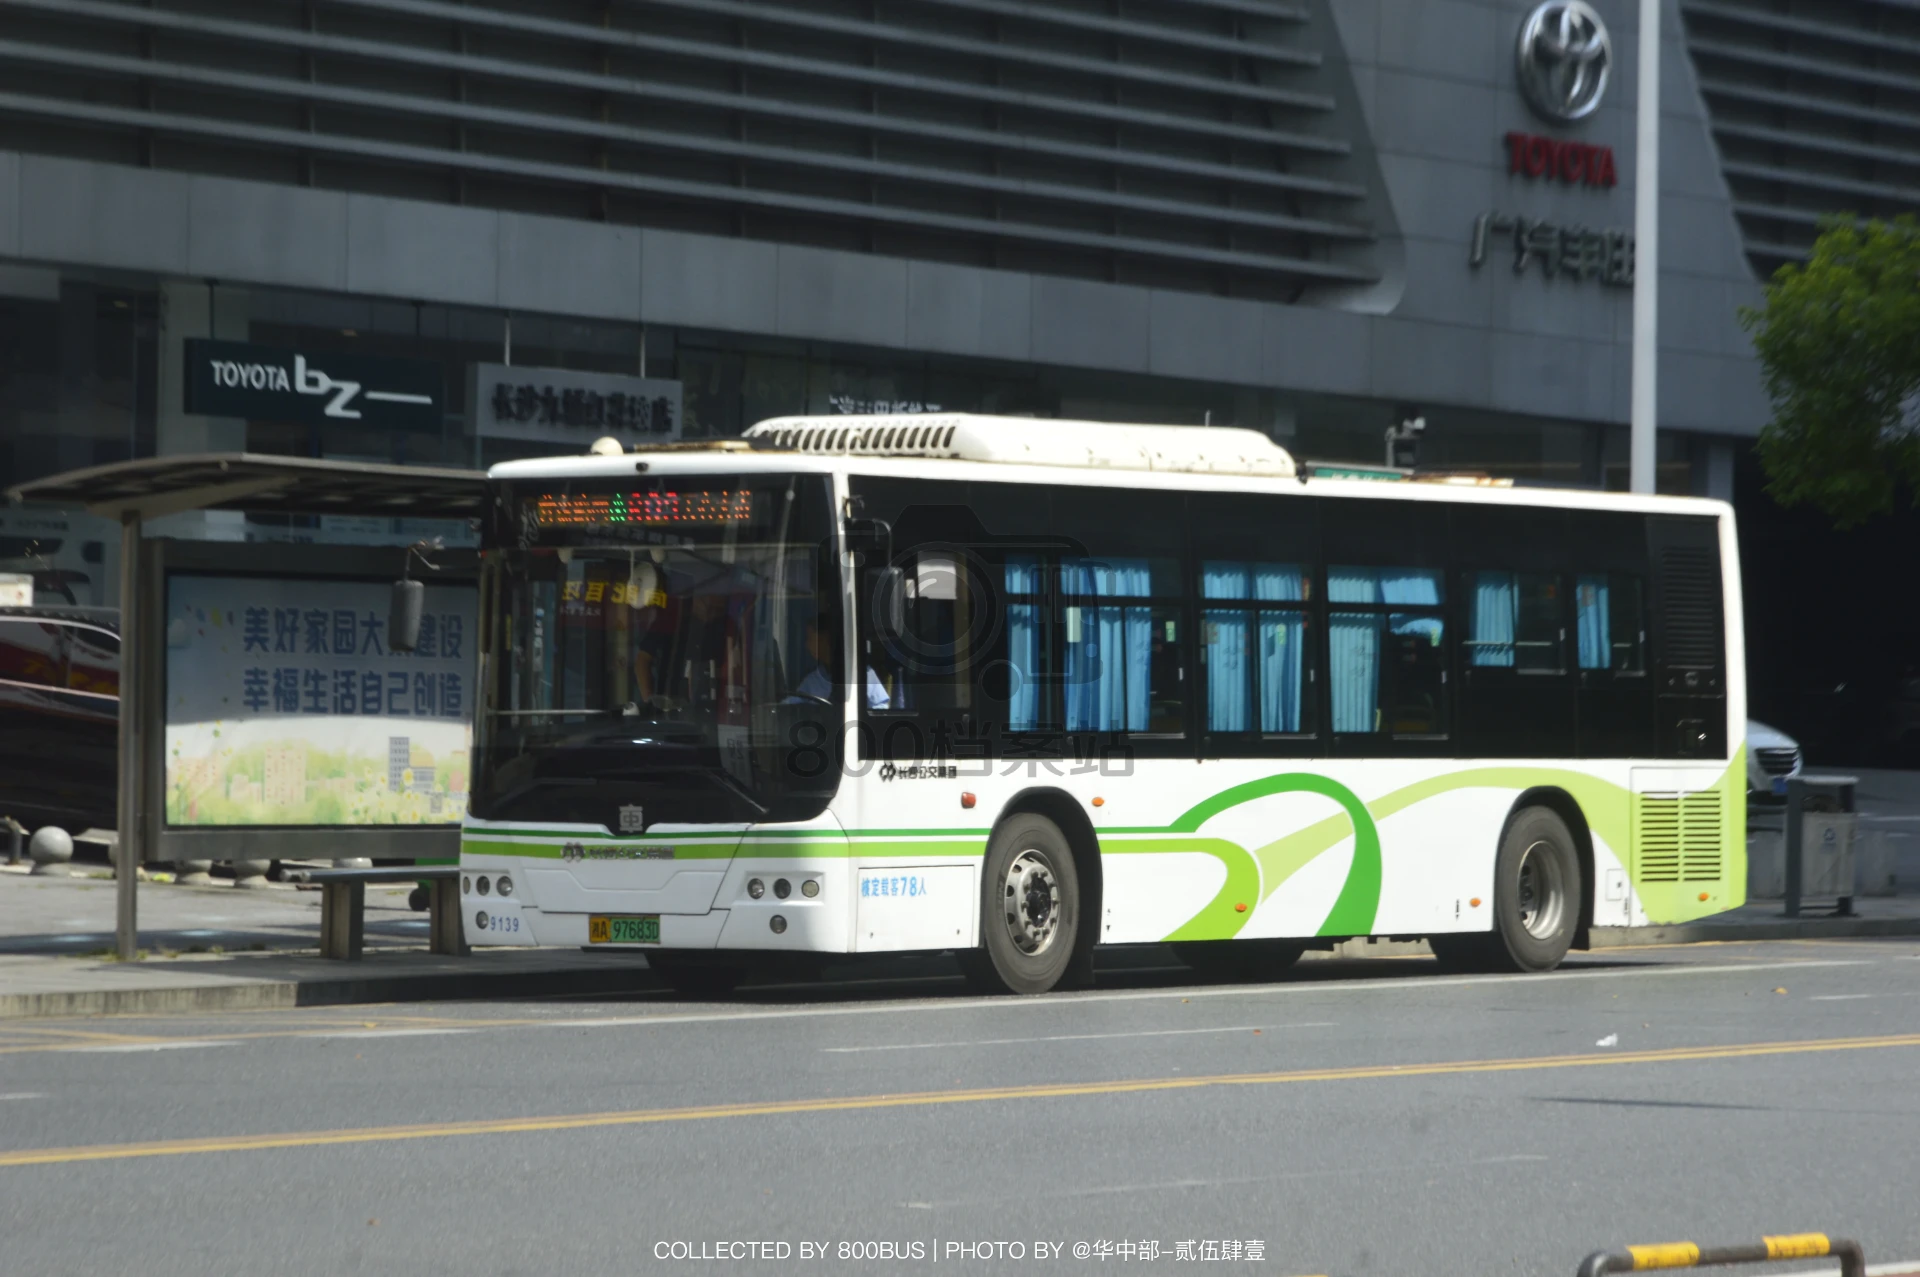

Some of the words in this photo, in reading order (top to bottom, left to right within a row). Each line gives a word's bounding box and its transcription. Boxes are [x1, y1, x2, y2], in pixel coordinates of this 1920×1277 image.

[1505, 132, 1618, 187] TOYOTA
[211, 359, 291, 393] TOYOTA
[243, 606, 463, 659] 美好家园大建设
[243, 667, 463, 718] 幸福生活自己创造
[490, 916, 519, 932] 9139
